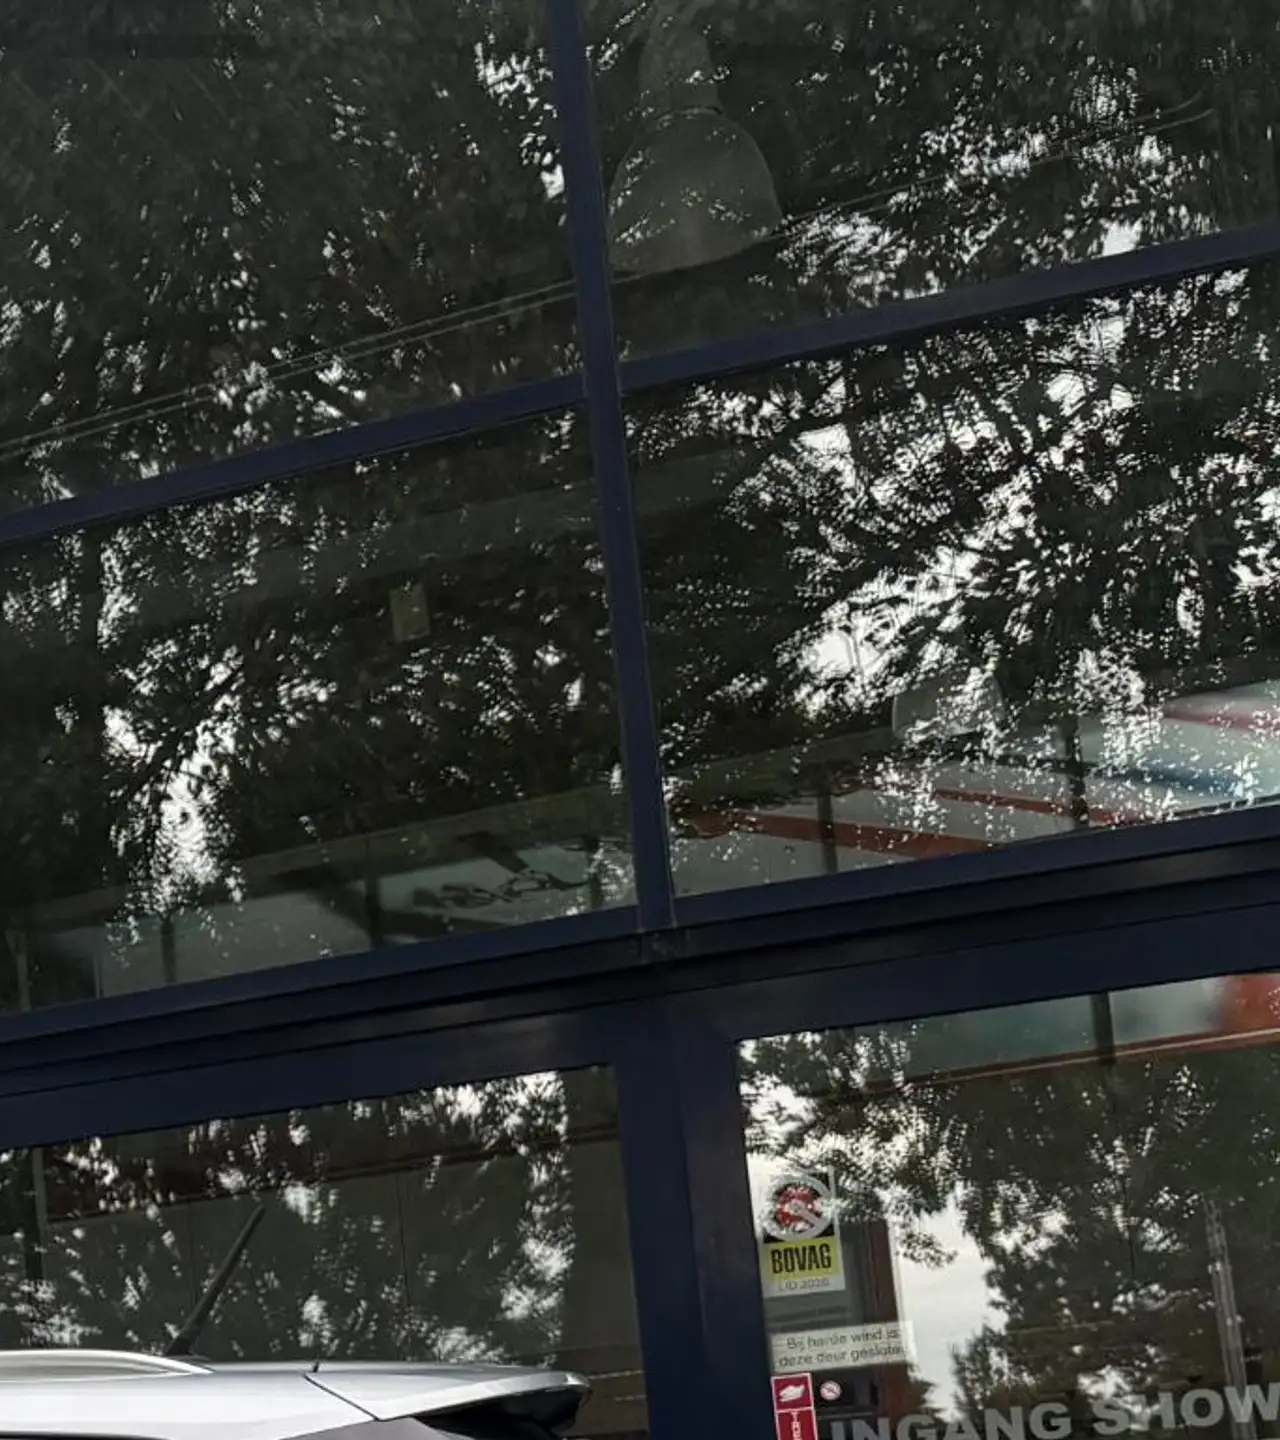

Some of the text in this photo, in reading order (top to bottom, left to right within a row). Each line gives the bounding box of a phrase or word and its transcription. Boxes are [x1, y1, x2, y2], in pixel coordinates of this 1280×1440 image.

[771, 1243, 832, 1274] BOVAG
[851, 1328, 883, 1342] wind
[778, 1352, 813, 1368] deze
[816, 1349, 848, 1364] deur
[1092, 1382, 1280, 1435] SHOW
